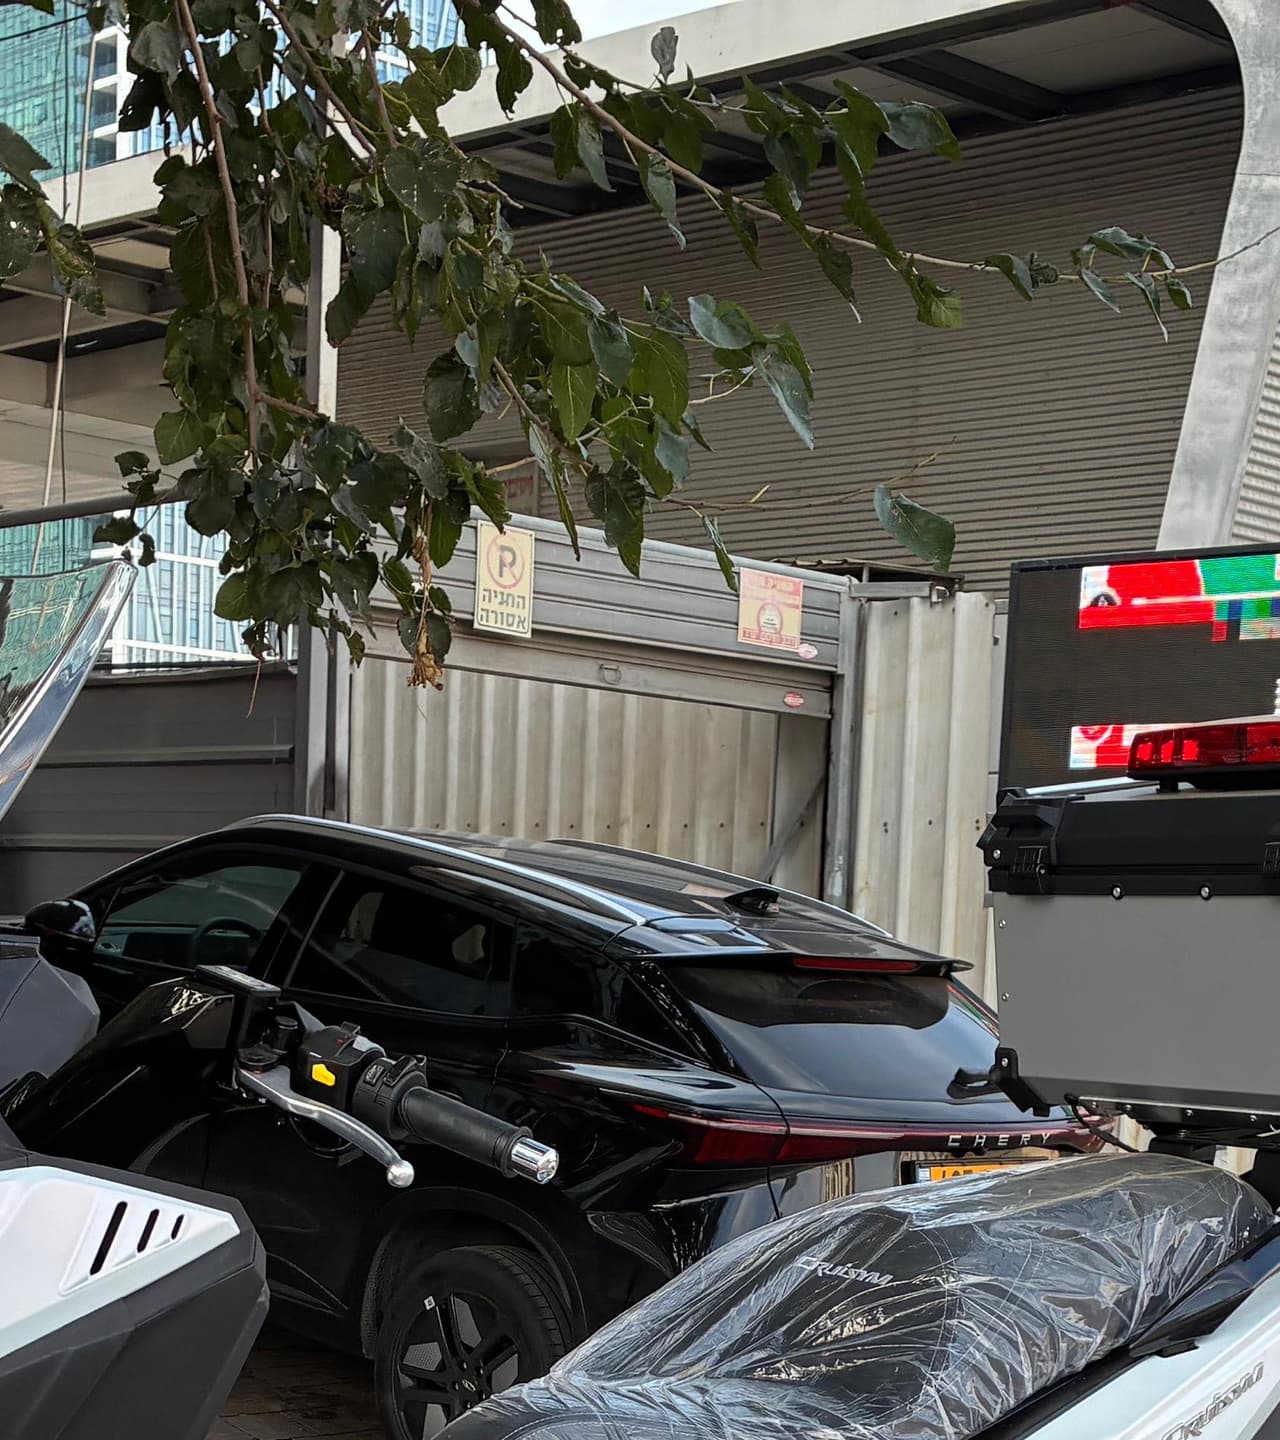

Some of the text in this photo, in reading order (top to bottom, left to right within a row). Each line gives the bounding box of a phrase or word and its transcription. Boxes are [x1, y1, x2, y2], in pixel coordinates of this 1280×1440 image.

[482, 588, 526, 610] החניה
[480, 608, 527, 630] אסורה
[946, 1132, 1051, 1147] CHERY
